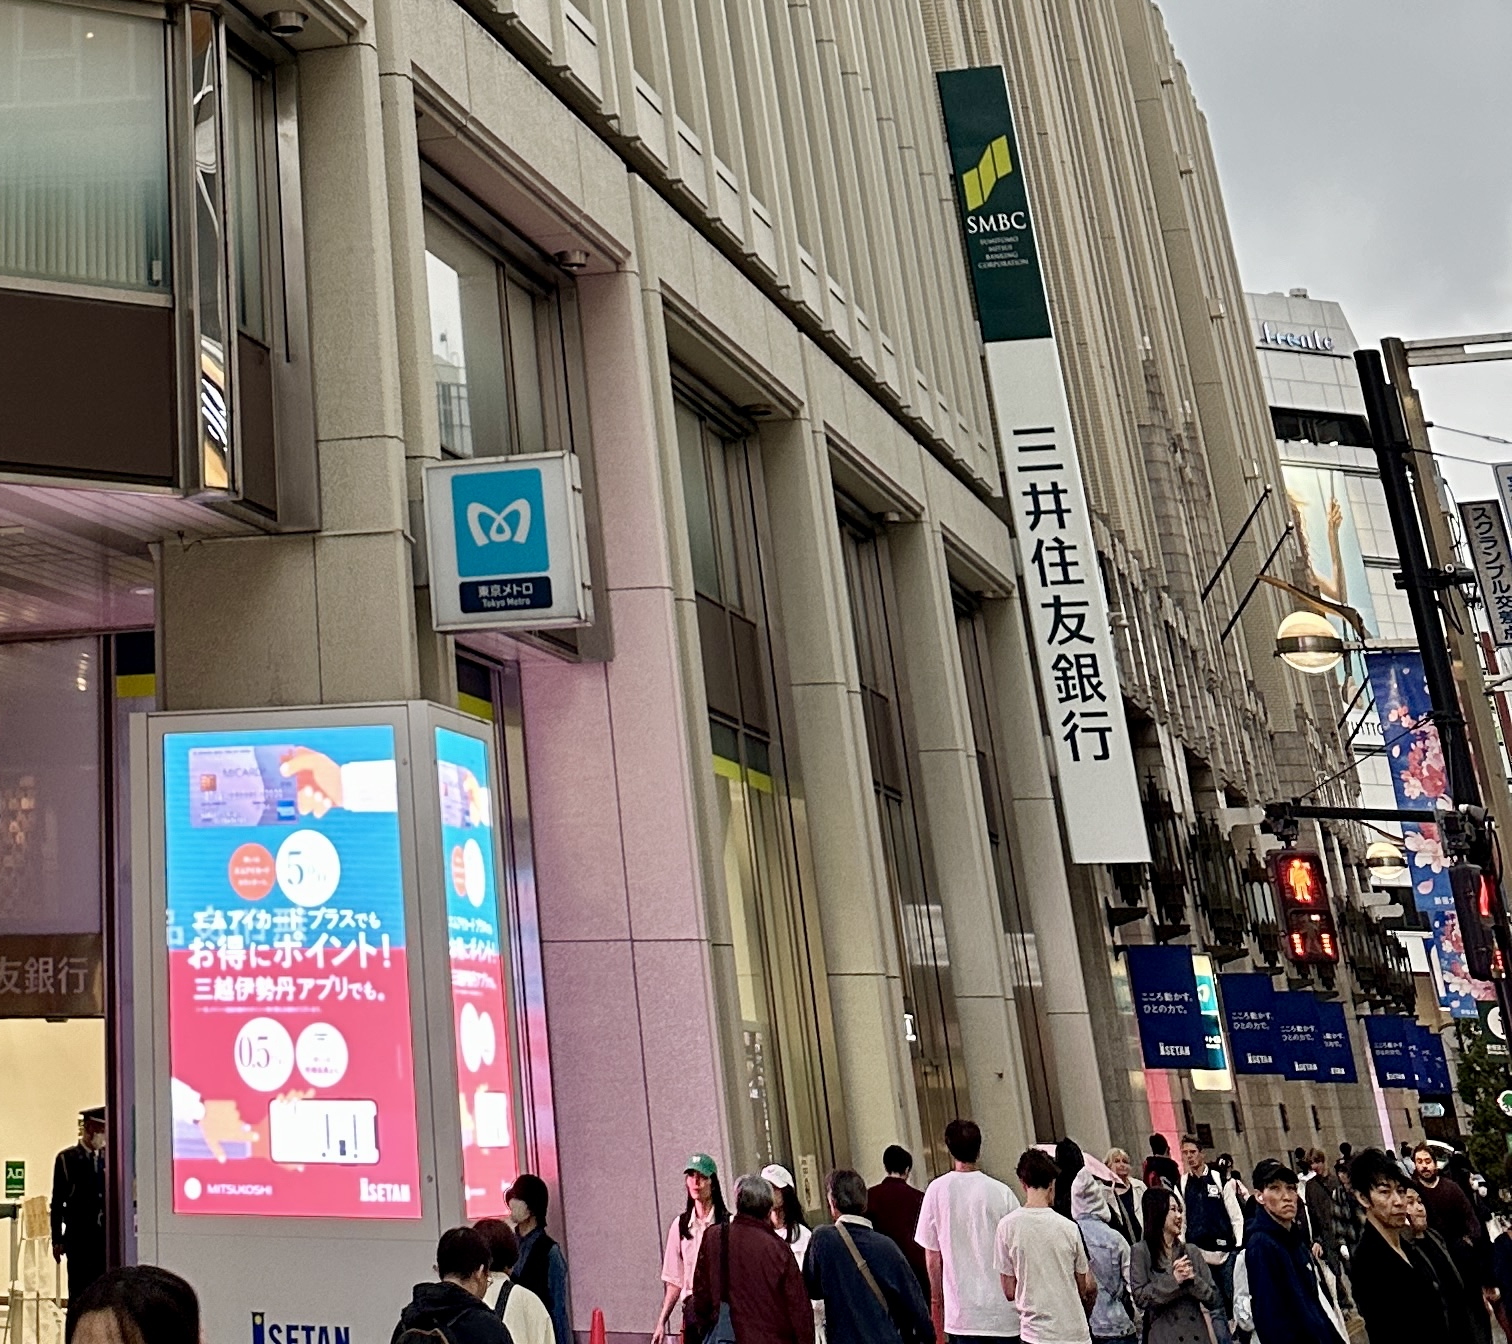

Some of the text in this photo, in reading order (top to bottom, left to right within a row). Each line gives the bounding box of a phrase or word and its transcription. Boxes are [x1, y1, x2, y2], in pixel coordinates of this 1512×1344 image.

[967, 211, 1027, 234] SMBC
[478, 583, 533, 598] 東京メトロ
[1013, 426, 1113, 762] 三井住友銀行
[482, 597, 531, 609] Tokyo Metro
[188, 932, 391, 970] お得にポイント!
[193, 975, 385, 1001] 三越伊勢丹アプリでも。
[1159, 1042, 1190, 1056] ISETAN
[7, 1168, 24, 1179] 入口
[207, 1183, 273, 1195] MITSUKOSHI
[360, 1177, 411, 1202] ISETAN
[251, 1312, 350, 1344] ISETAN
